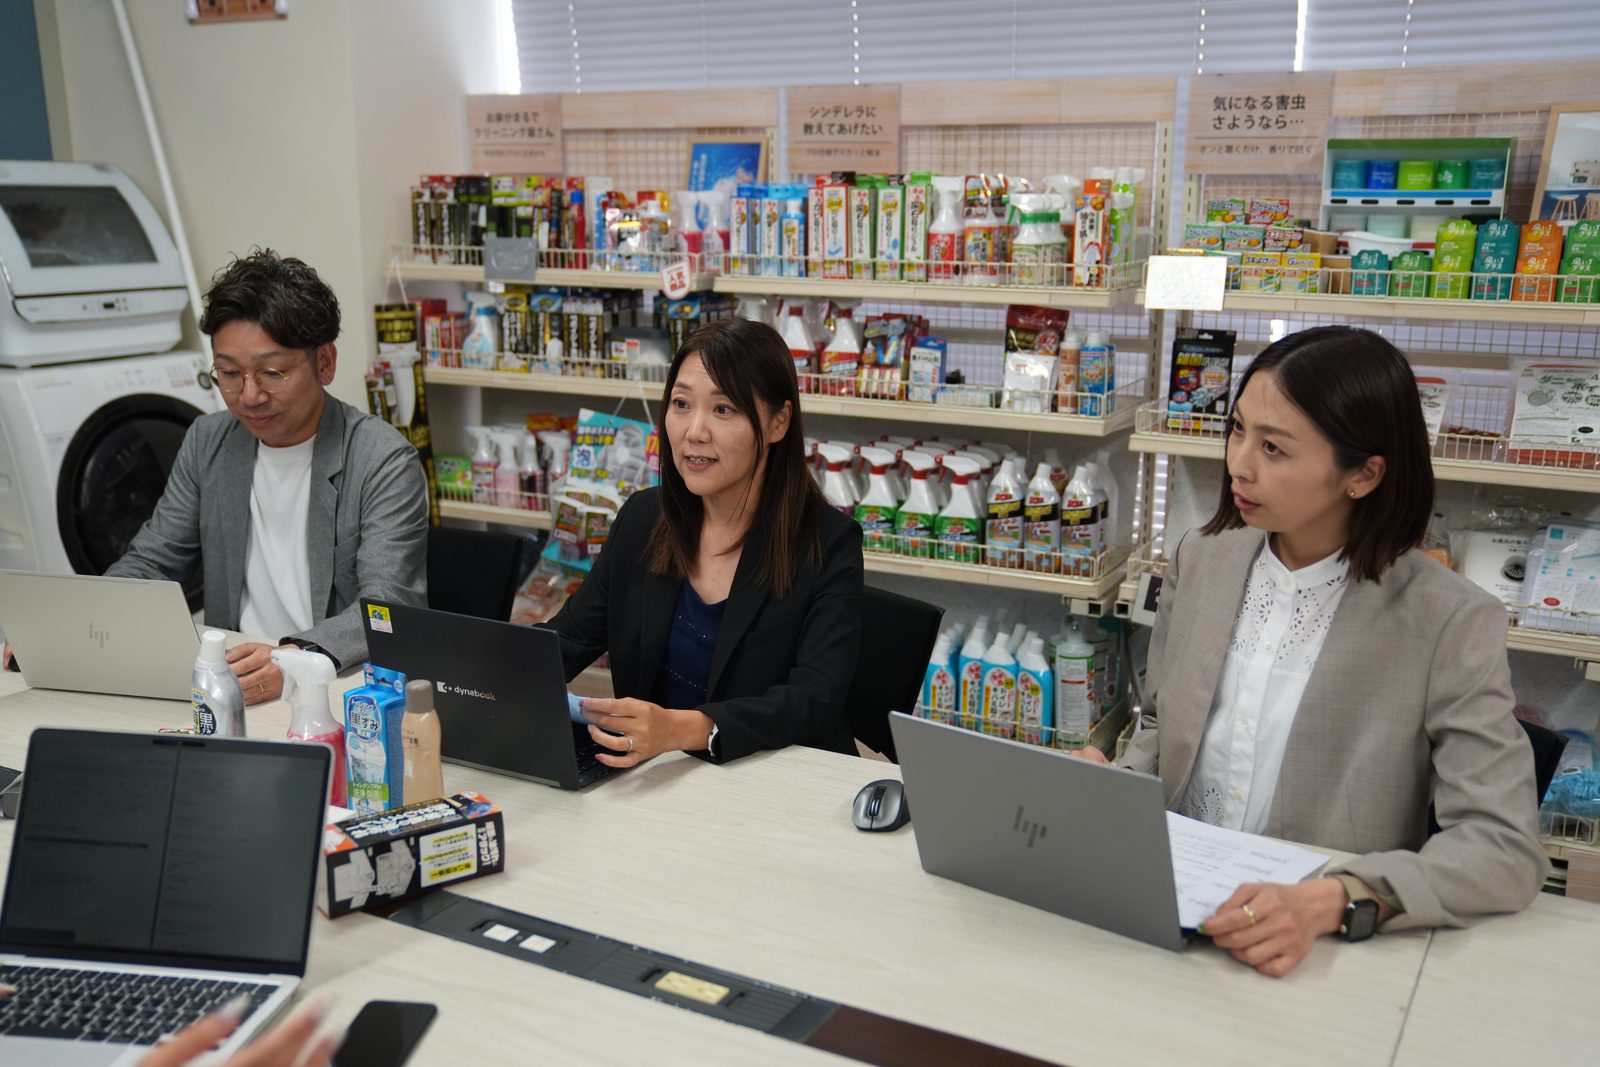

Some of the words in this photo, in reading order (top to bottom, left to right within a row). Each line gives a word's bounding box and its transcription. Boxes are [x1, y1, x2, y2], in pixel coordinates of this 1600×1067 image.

[1213, 94, 1306, 111] 気になる害虫
[809, 104, 877, 118] シンデレラに
[803, 122, 883, 135] 教えてあげたい
[454, 685, 496, 701] dynabook
